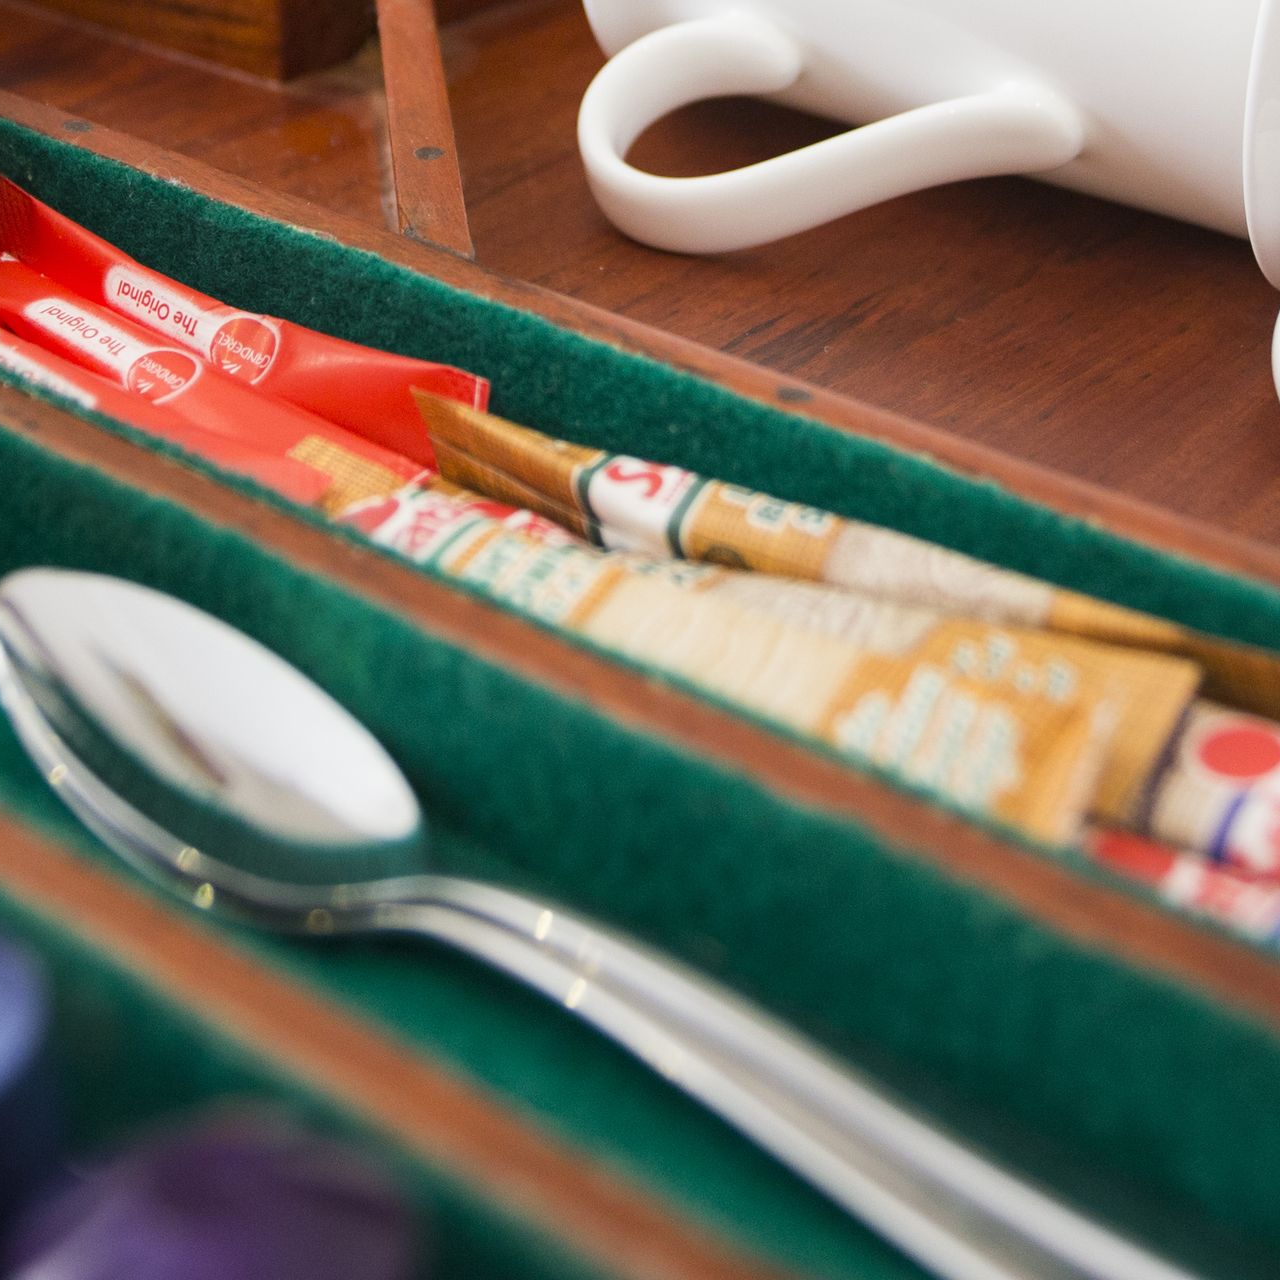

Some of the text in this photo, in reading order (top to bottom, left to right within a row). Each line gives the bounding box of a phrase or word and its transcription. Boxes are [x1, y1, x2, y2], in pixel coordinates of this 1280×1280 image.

[116, 279, 199, 337] The Original
[40, 305, 127, 357] The Original
[217, 330, 271, 369] CANDEREL
[138, 356, 186, 390] CANDEREL
